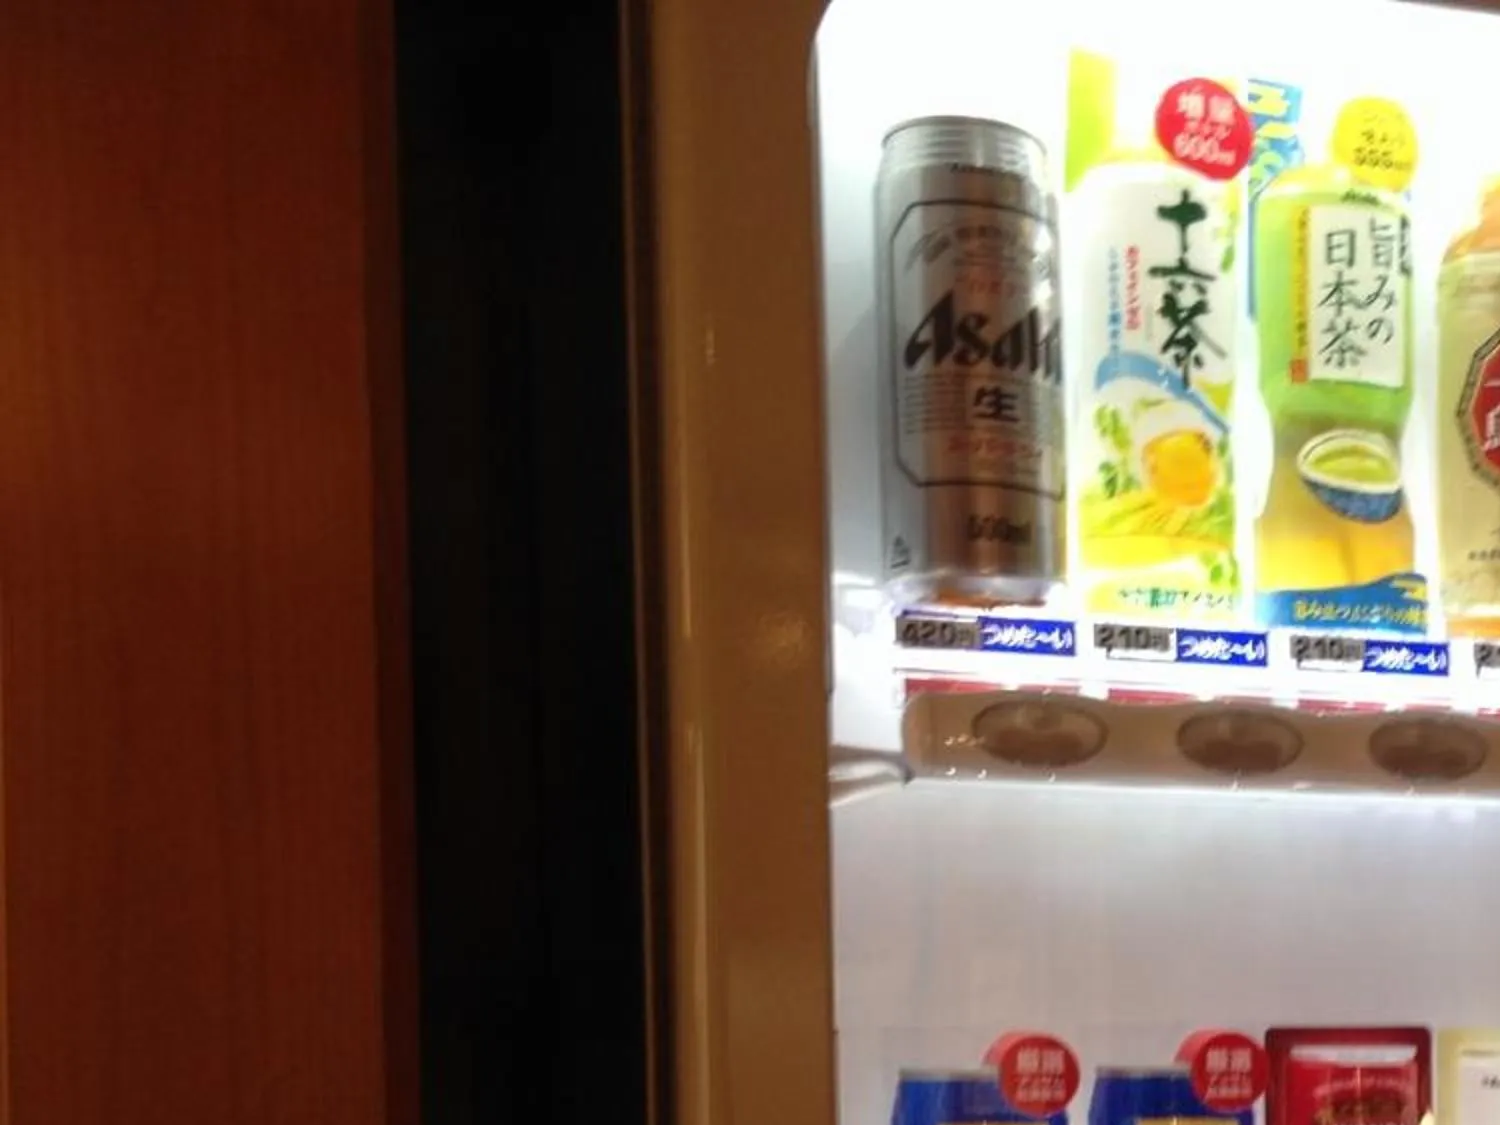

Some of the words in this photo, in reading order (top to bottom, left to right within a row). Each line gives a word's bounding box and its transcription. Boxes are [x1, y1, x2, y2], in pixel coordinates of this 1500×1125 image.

[904, 288, 1062, 386] Asah
[1147, 188, 1228, 390] 十六茶
[1318, 228, 1368, 369] 日本茶
[1366, 216, 1397, 346] 旨みの
